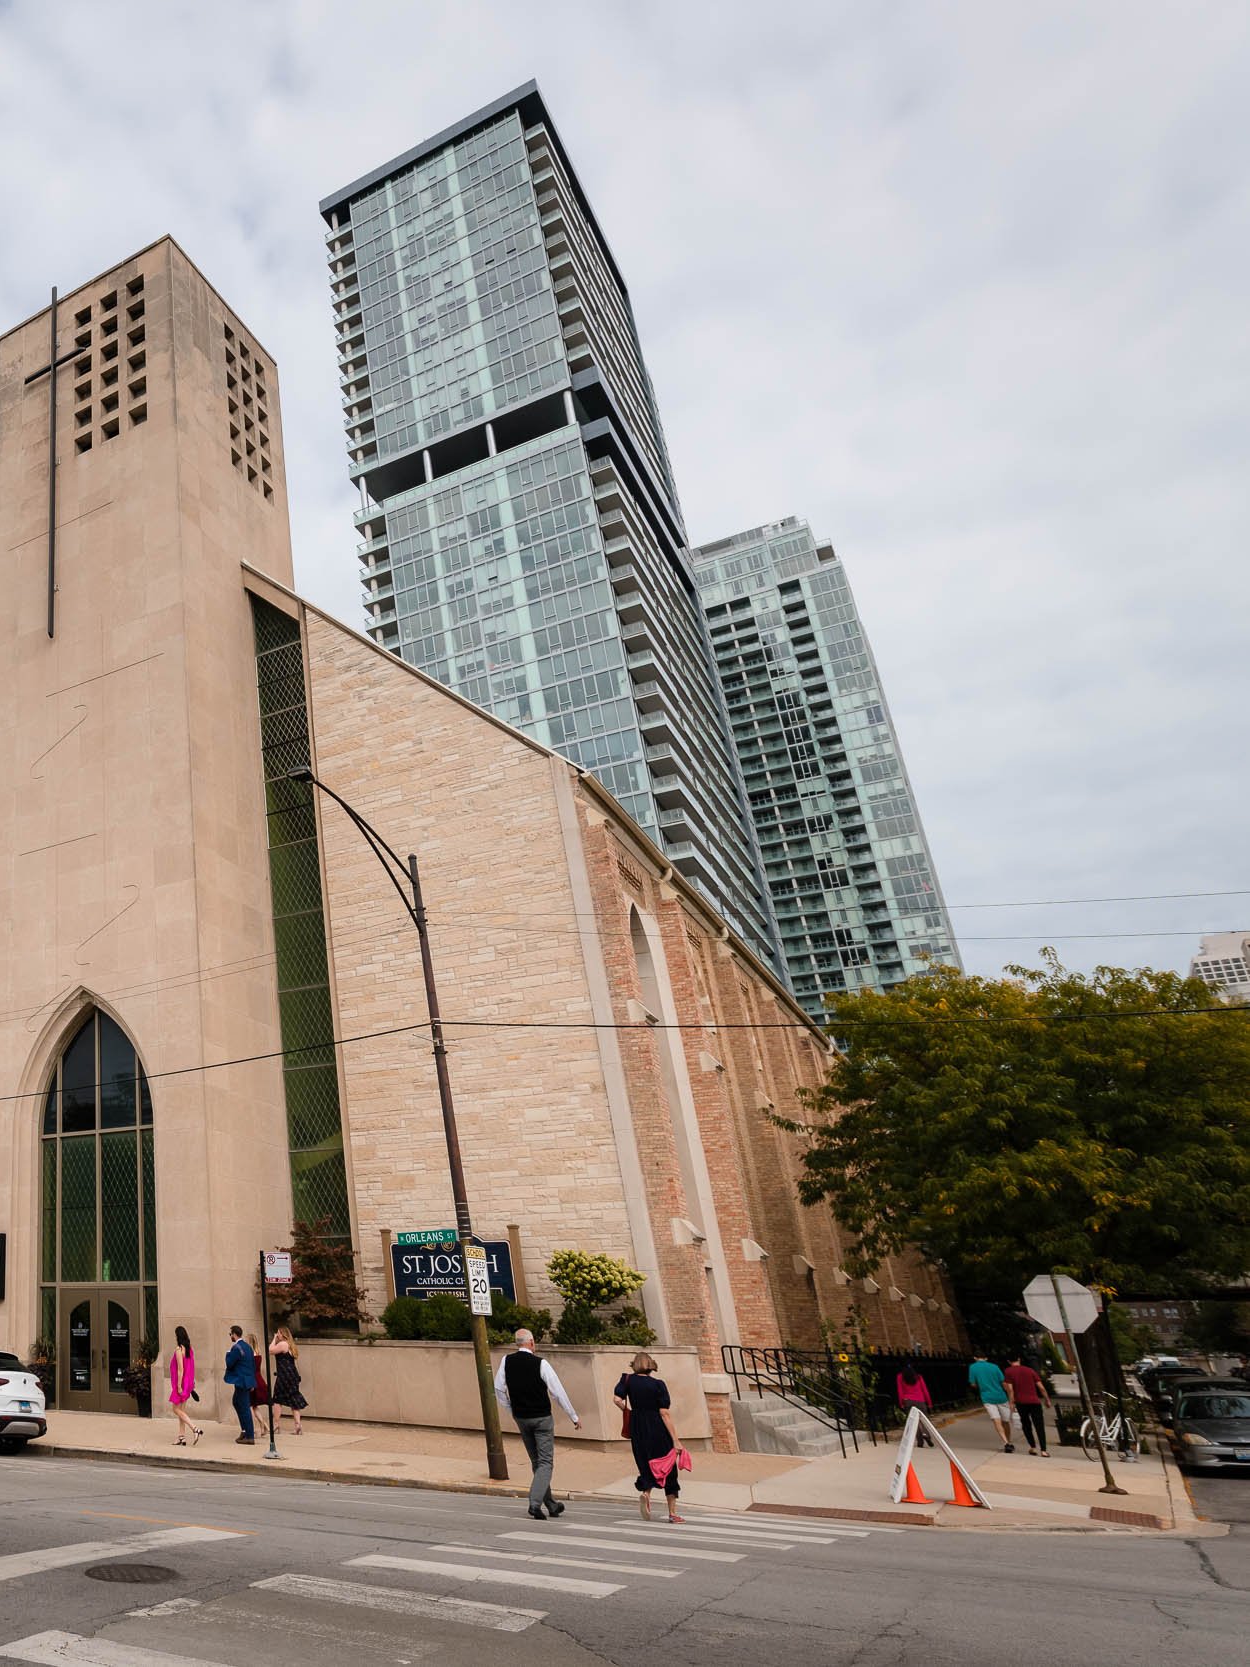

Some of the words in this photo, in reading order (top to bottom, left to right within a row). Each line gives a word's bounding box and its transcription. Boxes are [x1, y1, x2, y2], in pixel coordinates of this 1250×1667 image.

[405, 1231, 444, 1243] ORLEANS
[467, 1248, 485, 1257] SCHOOL
[402, 1255, 426, 1274] ST.
[469, 1260, 485, 1269] SPEED
[471, 1269, 485, 1277] LIMIT
[417, 1277, 454, 1285] CATHOLIC
[472, 1278, 487, 1294] 20
